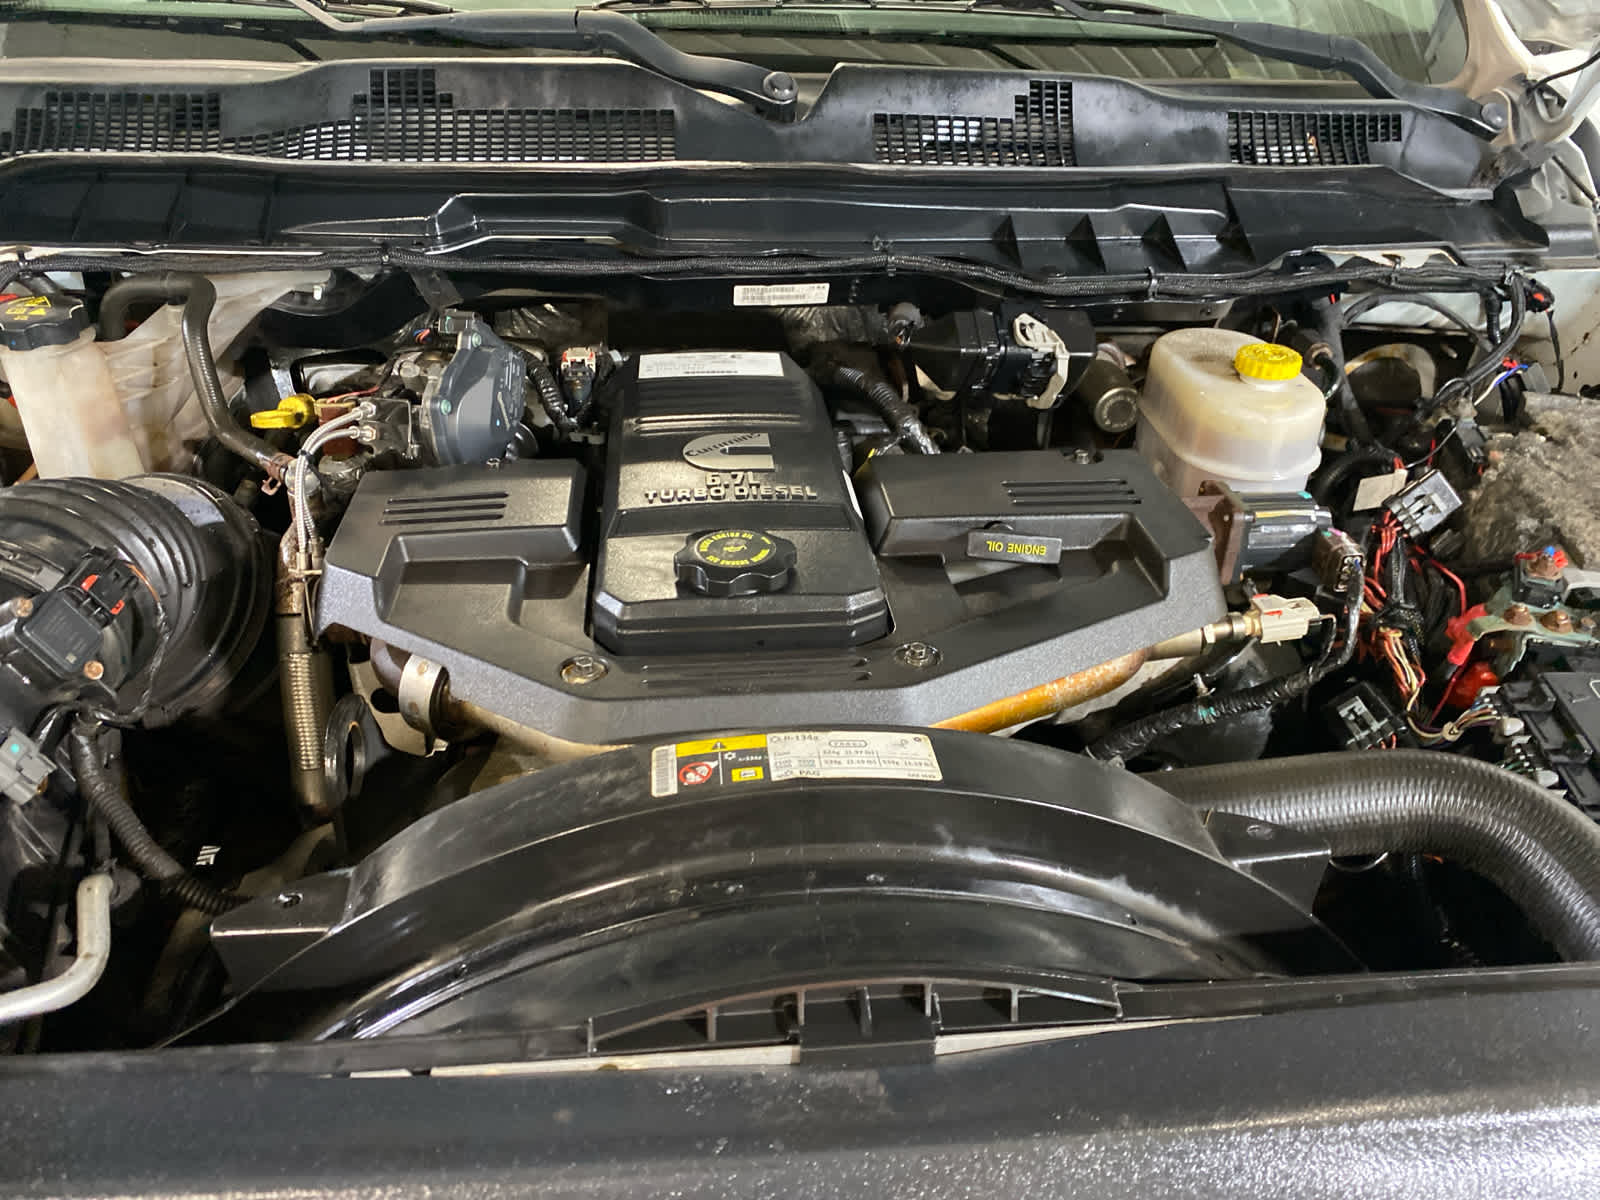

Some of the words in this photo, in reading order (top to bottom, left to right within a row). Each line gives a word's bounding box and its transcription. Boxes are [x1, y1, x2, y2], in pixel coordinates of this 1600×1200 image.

[684, 432, 761, 457] Cummins
[706, 471, 760, 488] 6.7L
[645, 486, 726, 504] TURBO
[734, 485, 818, 500] DIESEL
[986, 540, 1004, 552] OIL
[1006, 543, 1047, 556] ENGINE
